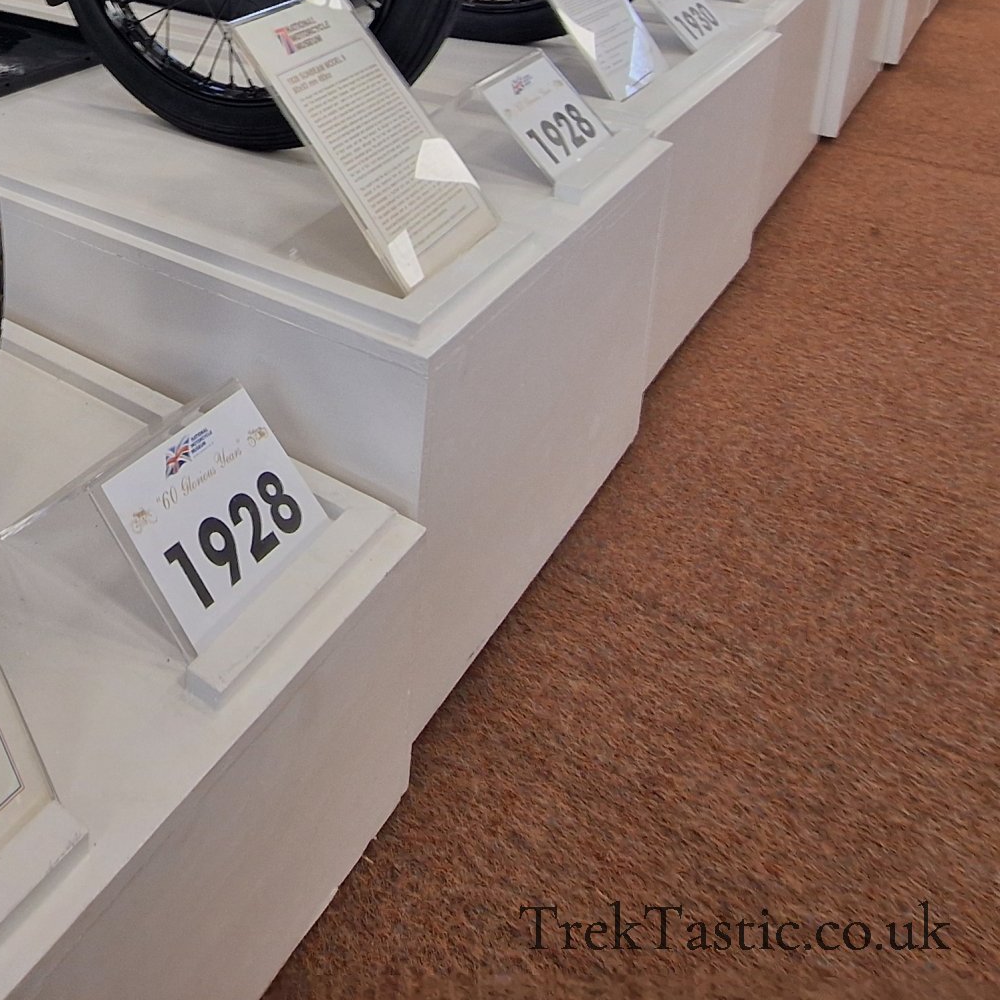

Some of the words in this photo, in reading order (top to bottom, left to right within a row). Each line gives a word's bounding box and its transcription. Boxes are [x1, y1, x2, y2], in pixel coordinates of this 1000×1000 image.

[673, 2, 719, 40] 1930
[526, 103, 596, 165] 1928
[164, 471, 302, 609] 1928
